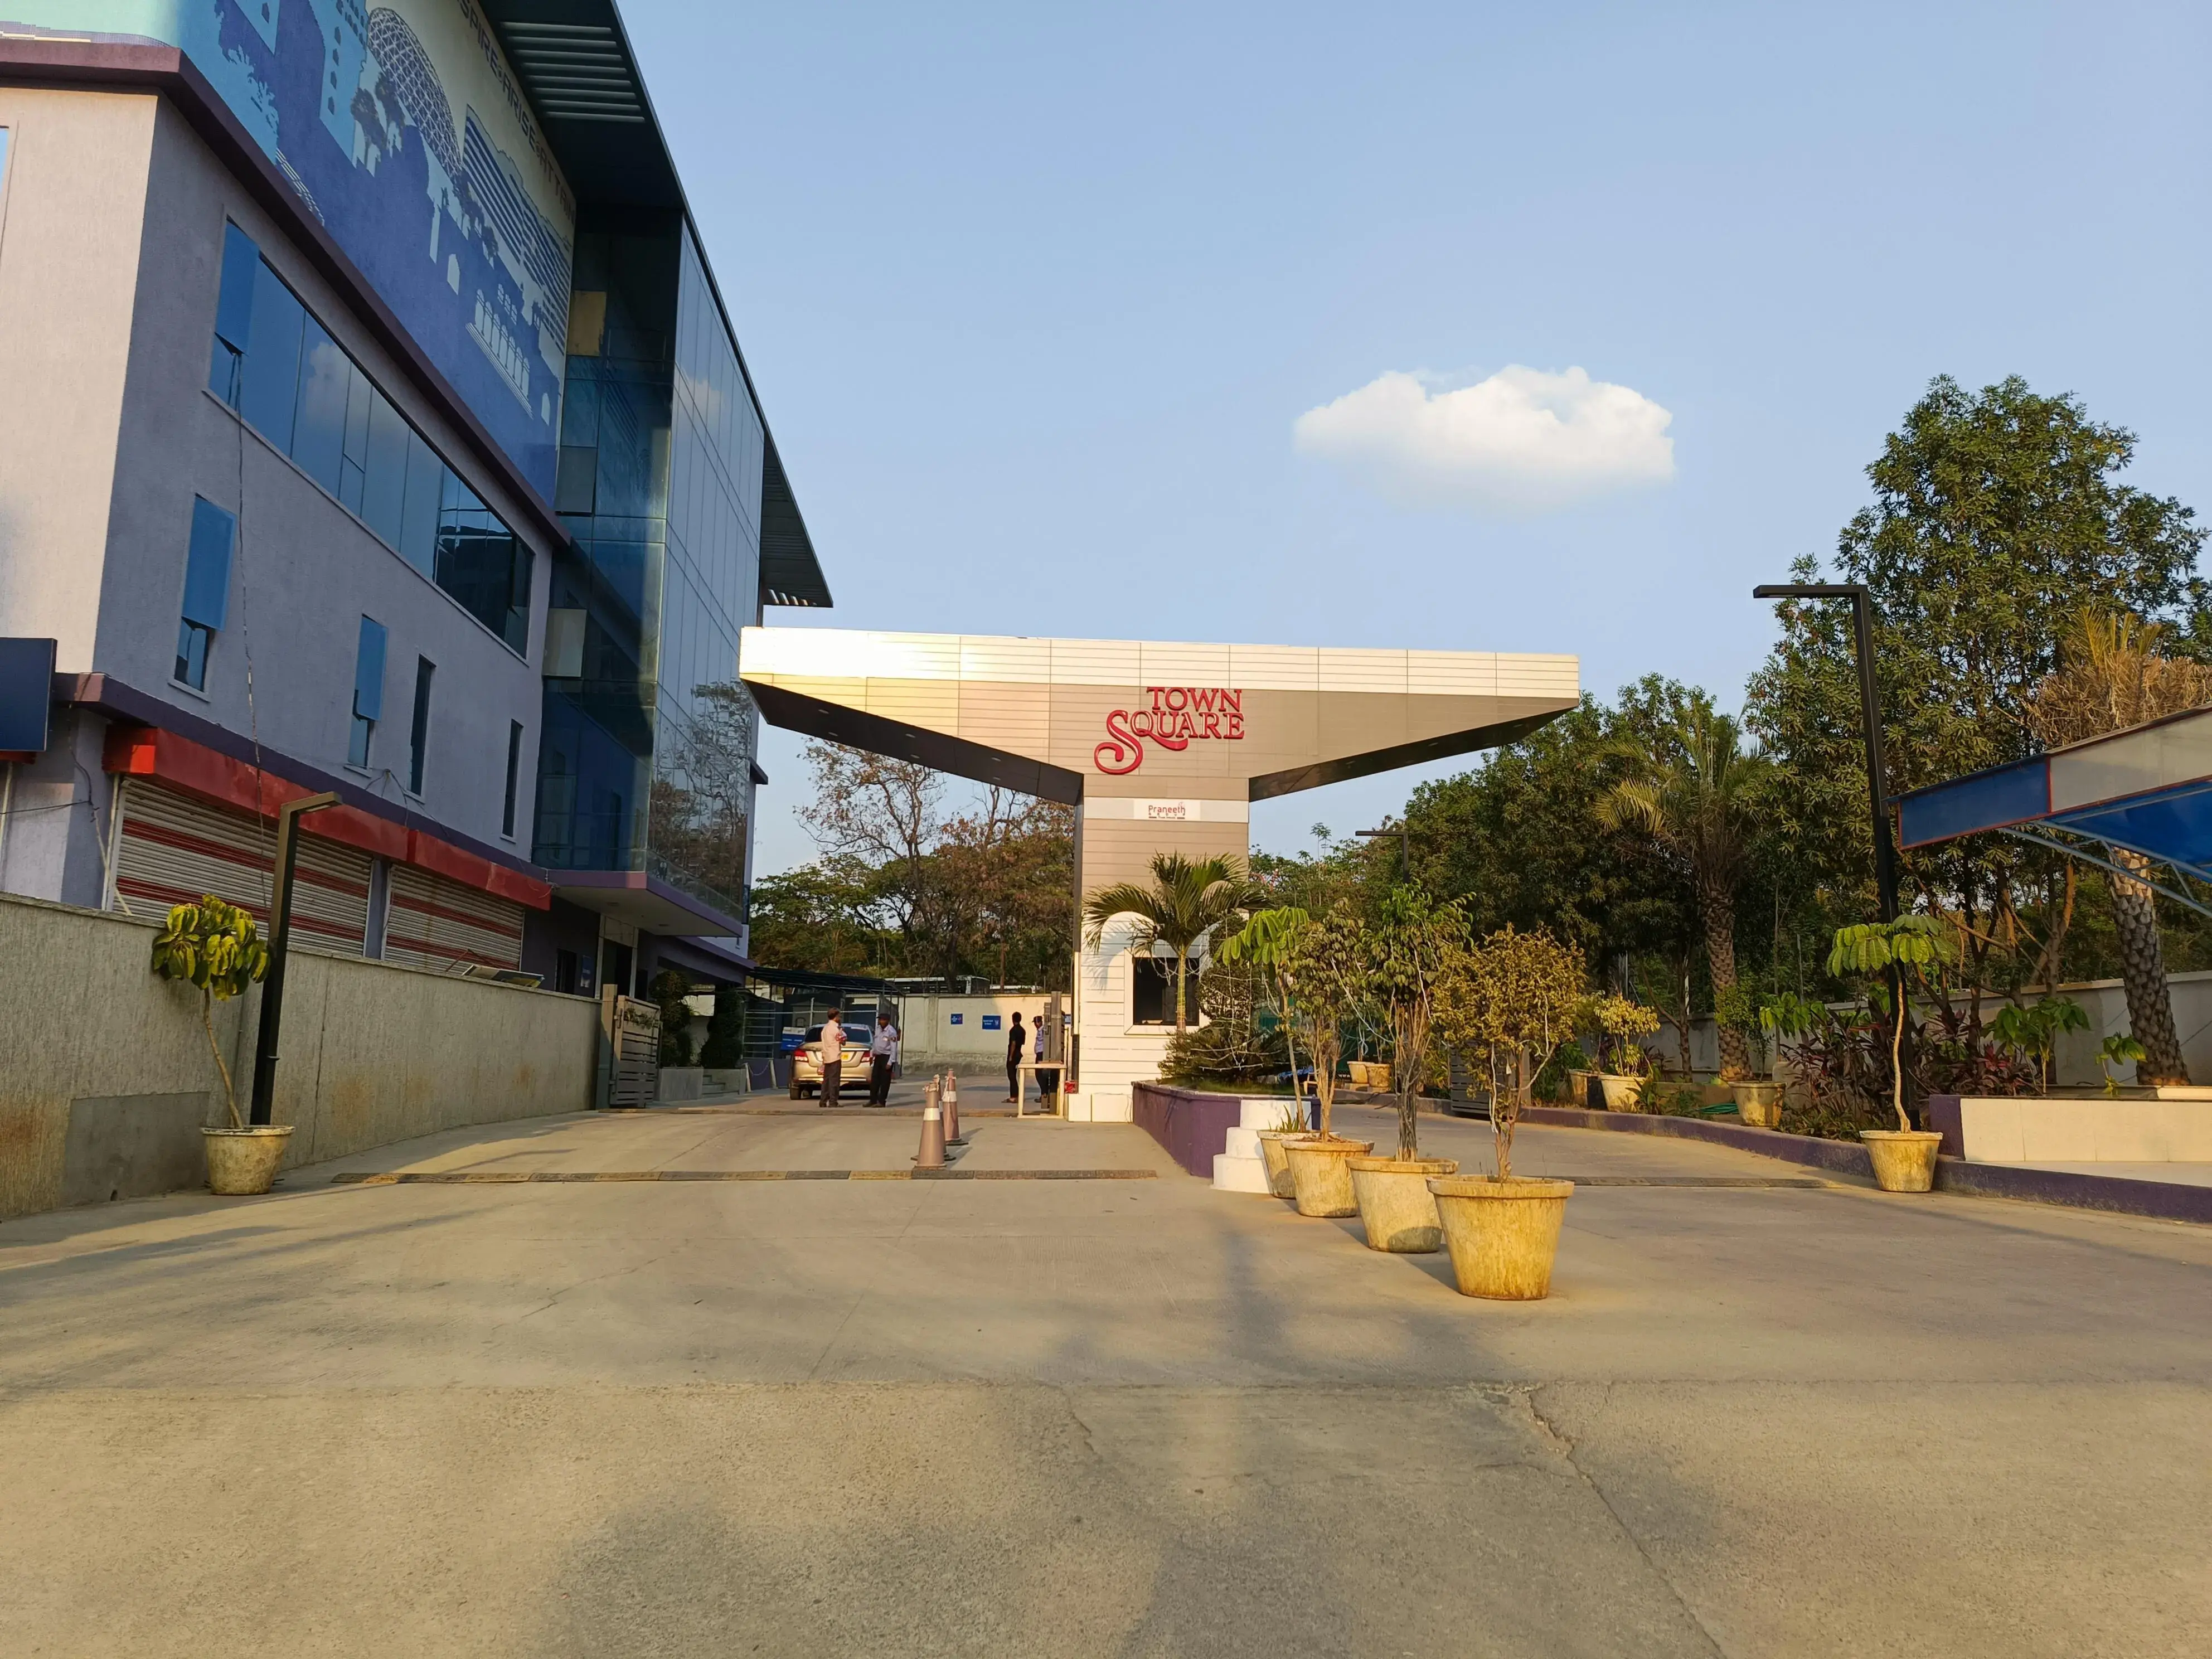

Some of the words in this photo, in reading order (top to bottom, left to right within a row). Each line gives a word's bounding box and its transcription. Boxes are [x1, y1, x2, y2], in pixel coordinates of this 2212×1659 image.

[457, 0, 498, 77] SPIRE
[503, 72, 536, 152] ARISE
[1146, 686, 1242, 712] TOWN
[1094, 710, 1245, 775] SQUARE
[1148, 804, 1186, 814] Praneeth
